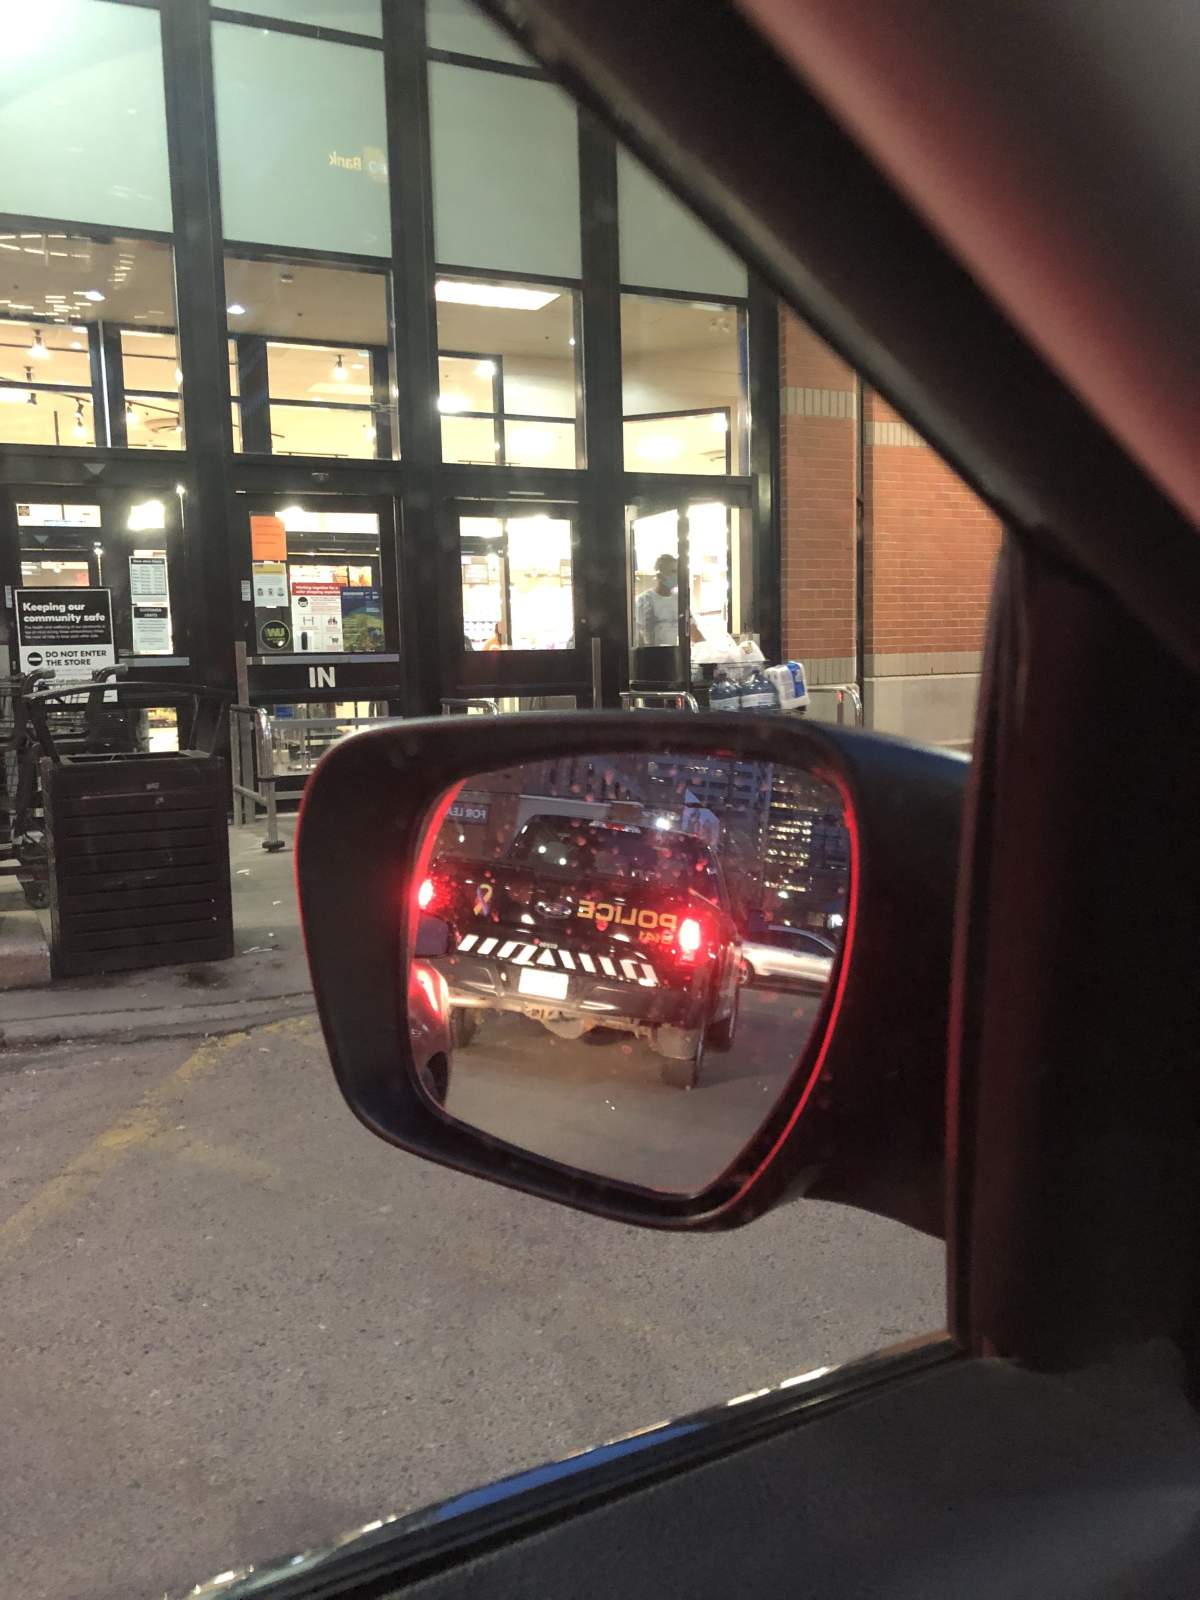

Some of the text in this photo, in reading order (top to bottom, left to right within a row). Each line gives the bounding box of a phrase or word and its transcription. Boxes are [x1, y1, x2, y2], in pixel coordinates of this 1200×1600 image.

[22, 602, 65, 613] Keeping
[23, 612, 106, 623] community safe
[309, 666, 336, 688] IN
